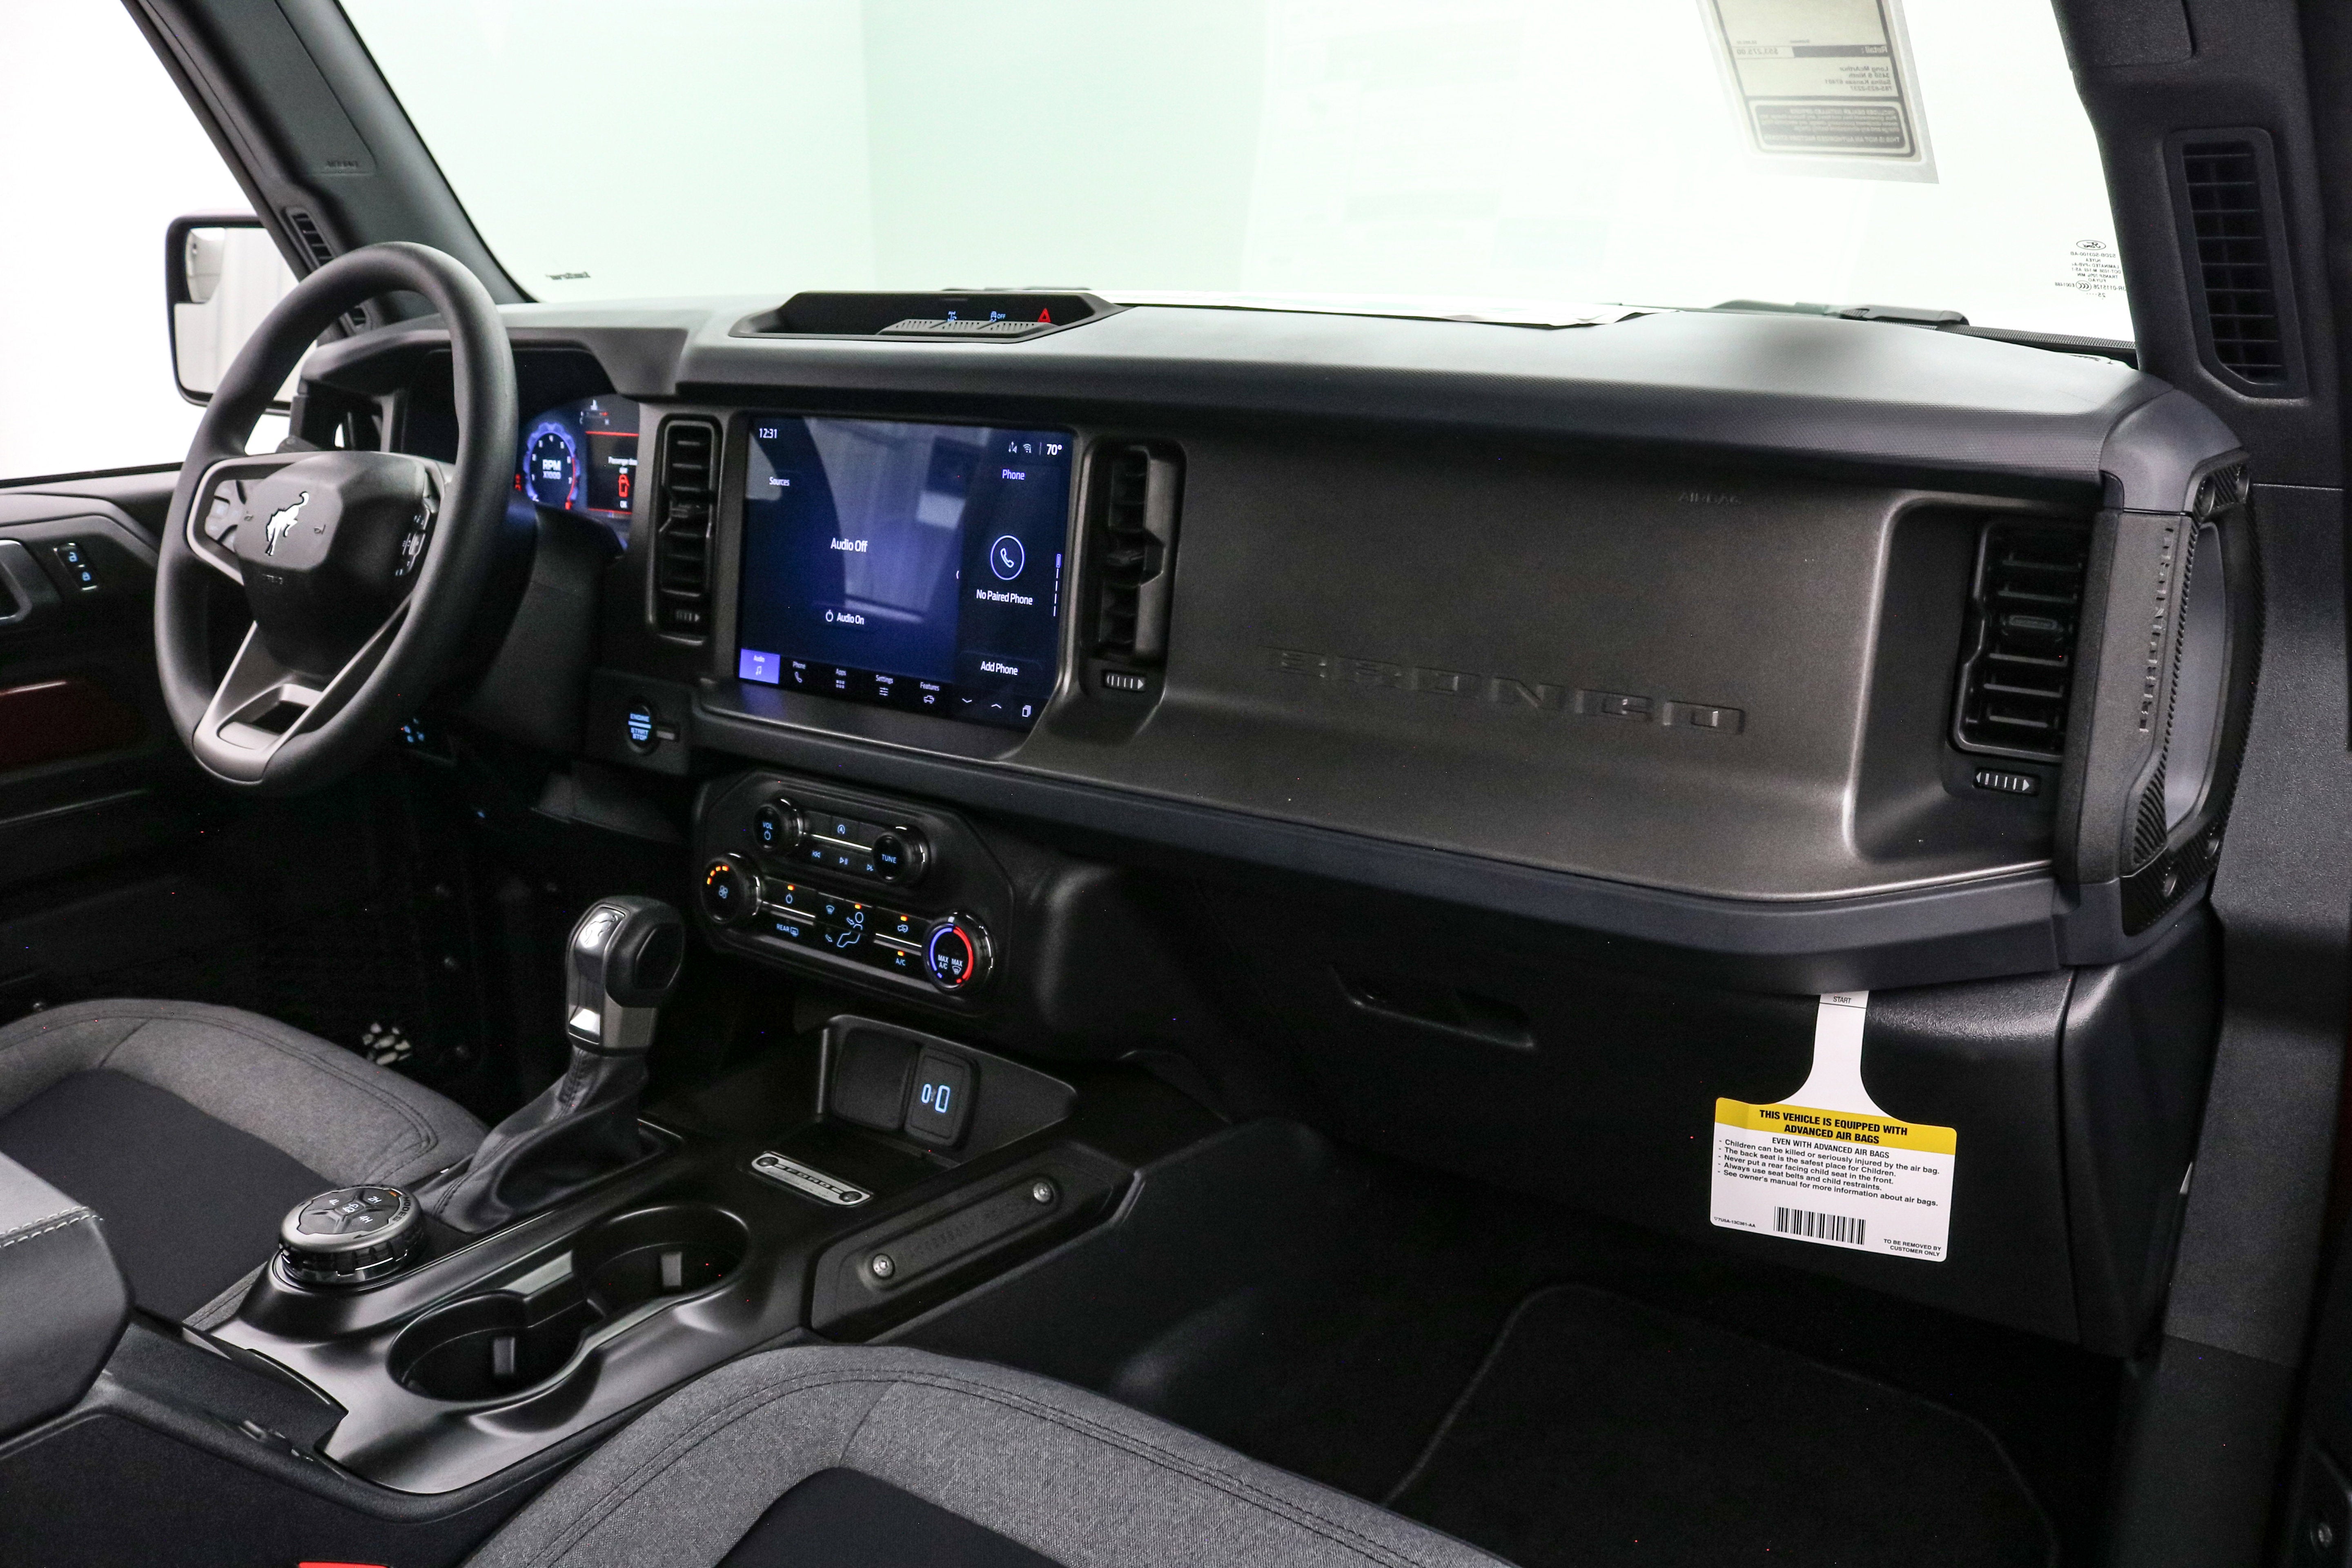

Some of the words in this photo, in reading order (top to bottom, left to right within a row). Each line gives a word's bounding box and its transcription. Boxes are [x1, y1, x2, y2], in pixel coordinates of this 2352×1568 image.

[759, 428, 777, 439] 12:31
[542, 459, 561, 471] RPM
[1002, 469, 1025, 480] Phone
[769, 477, 790, 486] Sources
[830, 538, 854, 552] Audio
[854, 540, 869, 553] Off
[976, 589, 987, 599] No
[987, 590, 1009, 602] Paired
[1010, 593, 1033, 605] Phone
[837, 612, 855, 624] Audio
[855, 615, 865, 625] On
[753, 655, 765, 663] Audio
[793, 661, 806, 670] Phone
[980, 661, 995, 672] Add
[996, 663, 1018, 675] Phone
[835, 668, 846, 677] Apps
[875, 675, 893, 684] Settings
[920, 682, 940, 691] Features
[882, 854, 897, 864] TUNE
[777, 924, 790, 933] REAR
[895, 958, 906, 966] A/C
[939, 961, 948, 969] A/C
[951, 958, 963, 967] MAX
[1760, 1109, 1780, 1120] THIS
[1783, 1112, 1820, 1125] VEHICLE
[1823, 1118, 1832, 1126] IS
[1835, 1119, 1880, 1132] EQUIPPED
[1883, 1125, 1907, 1136] WITH
[1784, 1124, 1833, 1138] ADVANCED
[1835, 1131, 1851, 1140] AIR
[1854, 1133, 1879, 1144] BAGS
[1772, 1137, 1791, 1145] EVEN
[1793, 1140, 1812, 1148] WITH
[1814, 1143, 1853, 1154] ADVANCED
[1870, 1150, 1889, 1158] BAGS
[1724, 1147, 1738, 1155] The
[1861, 1167, 1896, 1176] Children.
[1725, 1139, 1756, 1150] Children
[1785, 1148, 1805, 1156] killed
[1817, 1154, 1853, 1164] seriously
[1855, 1158, 1882, 1167] injured
[1884, 1161, 1893, 1169] by
[1923, 1166, 1939, 1175] bag.
[1724, 1154, 1746, 1163] Never
[1785, 1164, 1808, 1174] facing
[1873, 1176, 1893, 1184] front.
[1724, 1162, 1750, 1172] Always
[1843, 1181, 1882, 1191] restraints.
[1739, 1174, 1768, 1182] owner's
[1770, 1178, 1797, 1187] manual
[1834, 1186, 1878, 1198] information
[1880, 1193, 1902, 1201] about
[1917, 1198, 1938, 1207] bags.
[392, 1196, 411, 1222] MODES
[1890, 1245, 1923, 1254] CUSTOMER
[1902, 1241, 1932, 1250] REMOVED
